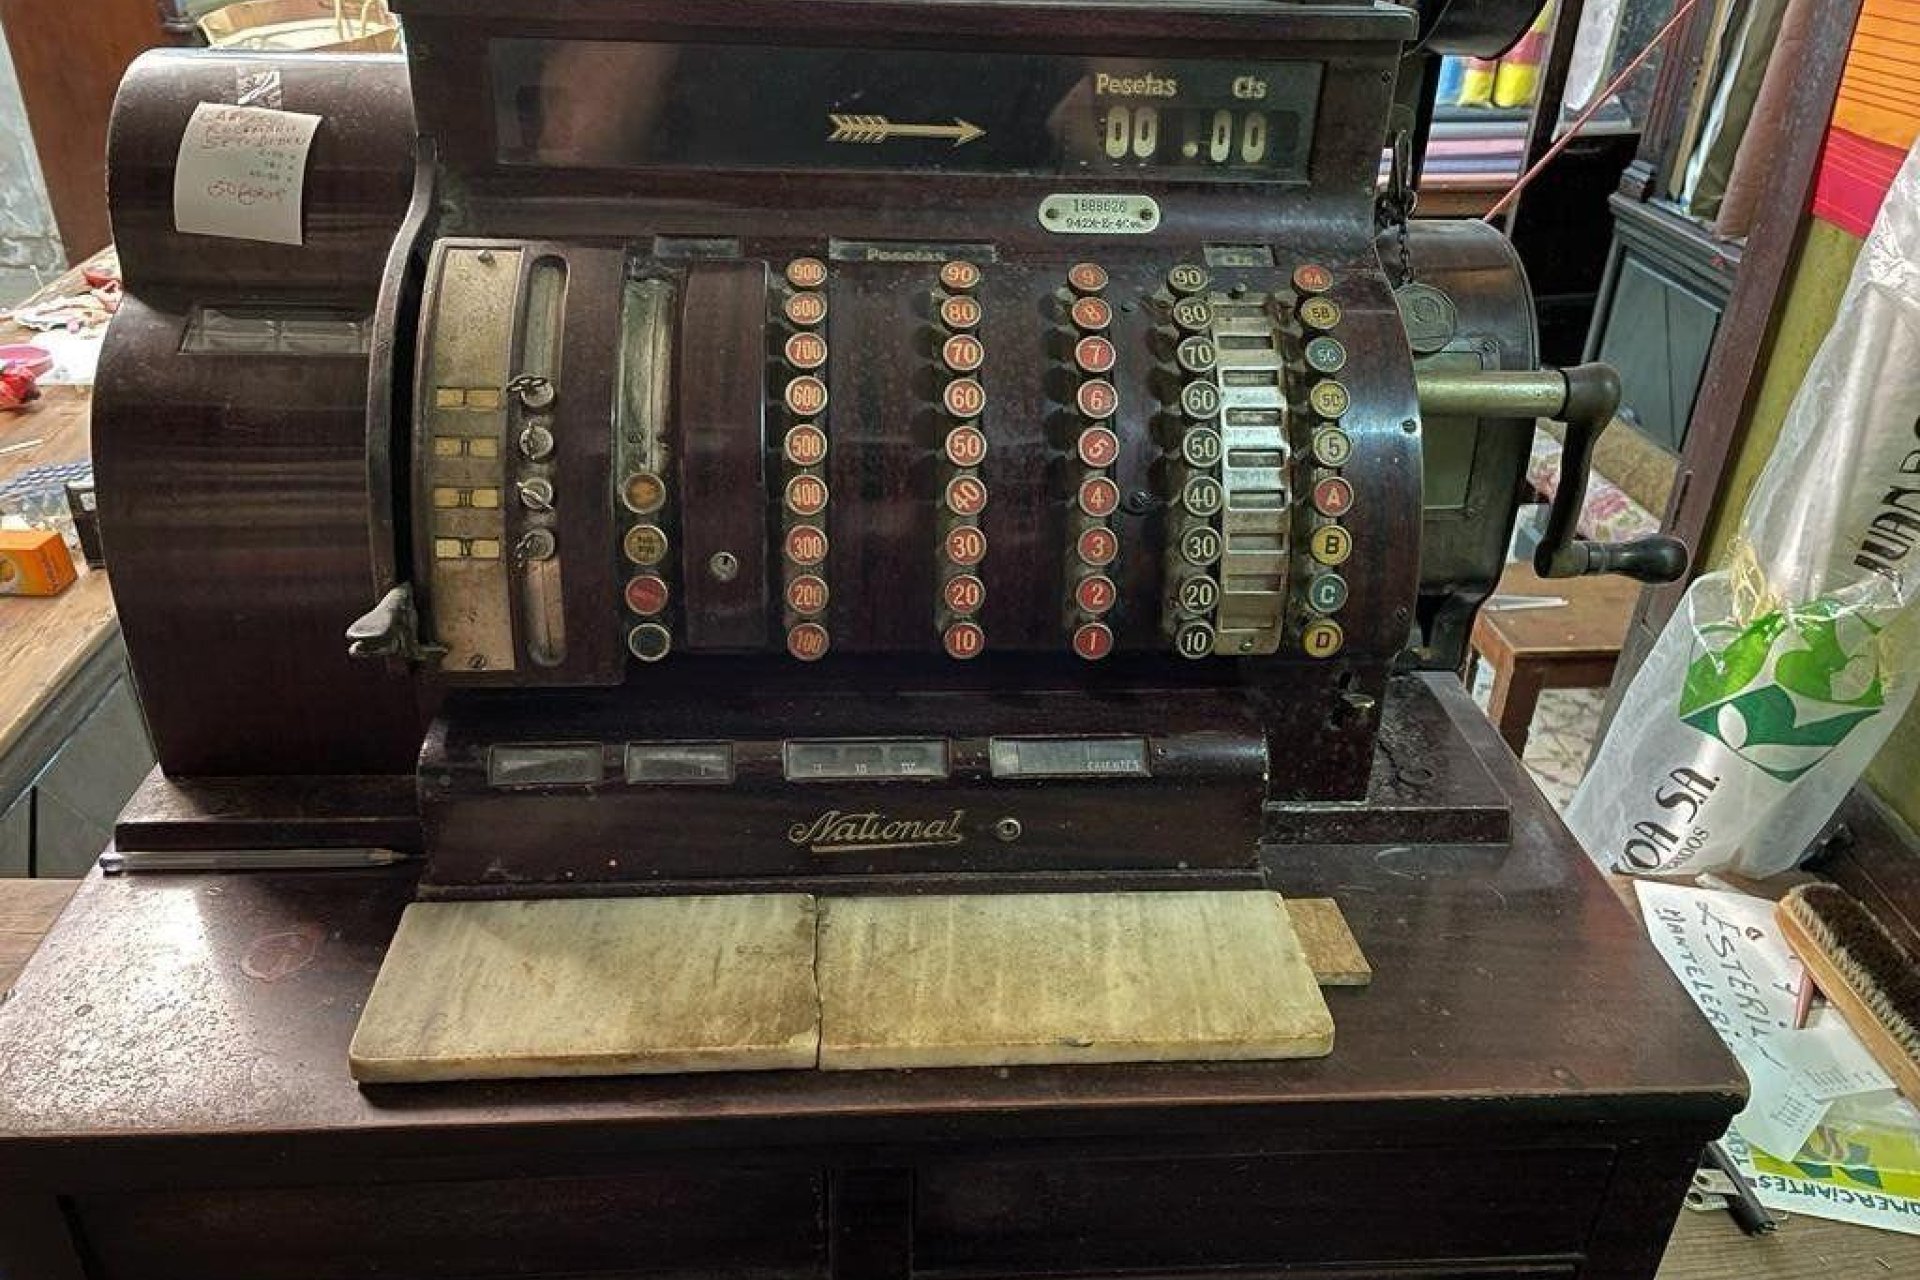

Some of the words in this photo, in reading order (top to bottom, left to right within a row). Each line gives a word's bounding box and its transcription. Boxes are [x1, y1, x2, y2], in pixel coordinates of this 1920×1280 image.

[1095, 72, 1177, 96] Pesetas
[1232, 76, 1266, 98] Cts
[1106, 107, 1157, 158] 00
[794, 264, 819, 280] 900
[949, 267, 972, 282] 90
[1082, 271, 1094, 284] 9
[1175, 271, 1200, 284] 90
[949, 304, 974, 320] 80
[1086, 307, 1097, 321] 8
[1181, 306, 1206, 323] 80
[795, 341, 821, 360] 700
[951, 343, 976, 363] 70
[1086, 345, 1100, 363] 7
[1185, 346, 1211, 363] 70
[793, 386, 821, 406] 600
[952, 388, 978, 408] 60
[1091, 390, 1104, 410] 6
[1189, 390, 1213, 411] 60
[792, 435, 820, 457] 500
[954, 435, 981, 456] 50
[1089, 440, 1107, 457] 5
[1191, 436, 1218, 458] 50
[1327, 438, 1338, 458] 5
[952, 483, 980, 509] 40
[1090, 487, 1105, 505] 4
[1191, 488, 1216, 507] 40
[1326, 487, 1339, 505] A
[794, 536, 822, 559] 300
[953, 534, 980, 557] 30
[1092, 536, 1104, 556] 3
[1190, 536, 1215, 558] 30
[1326, 535, 1339, 554] B
[795, 585, 822, 605] 200
[952, 584, 979, 605] 20
[1091, 586, 1104, 604] 2
[1186, 585, 1211, 606] 20
[1320, 585, 1335, 604] C
[955, 630, 976, 650] 10
[1186, 632, 1206, 651] 10
[1316, 632, 1330, 649] D
[1655, 767, 1720, 823] S.A.
[788, 810, 965, 849] National
